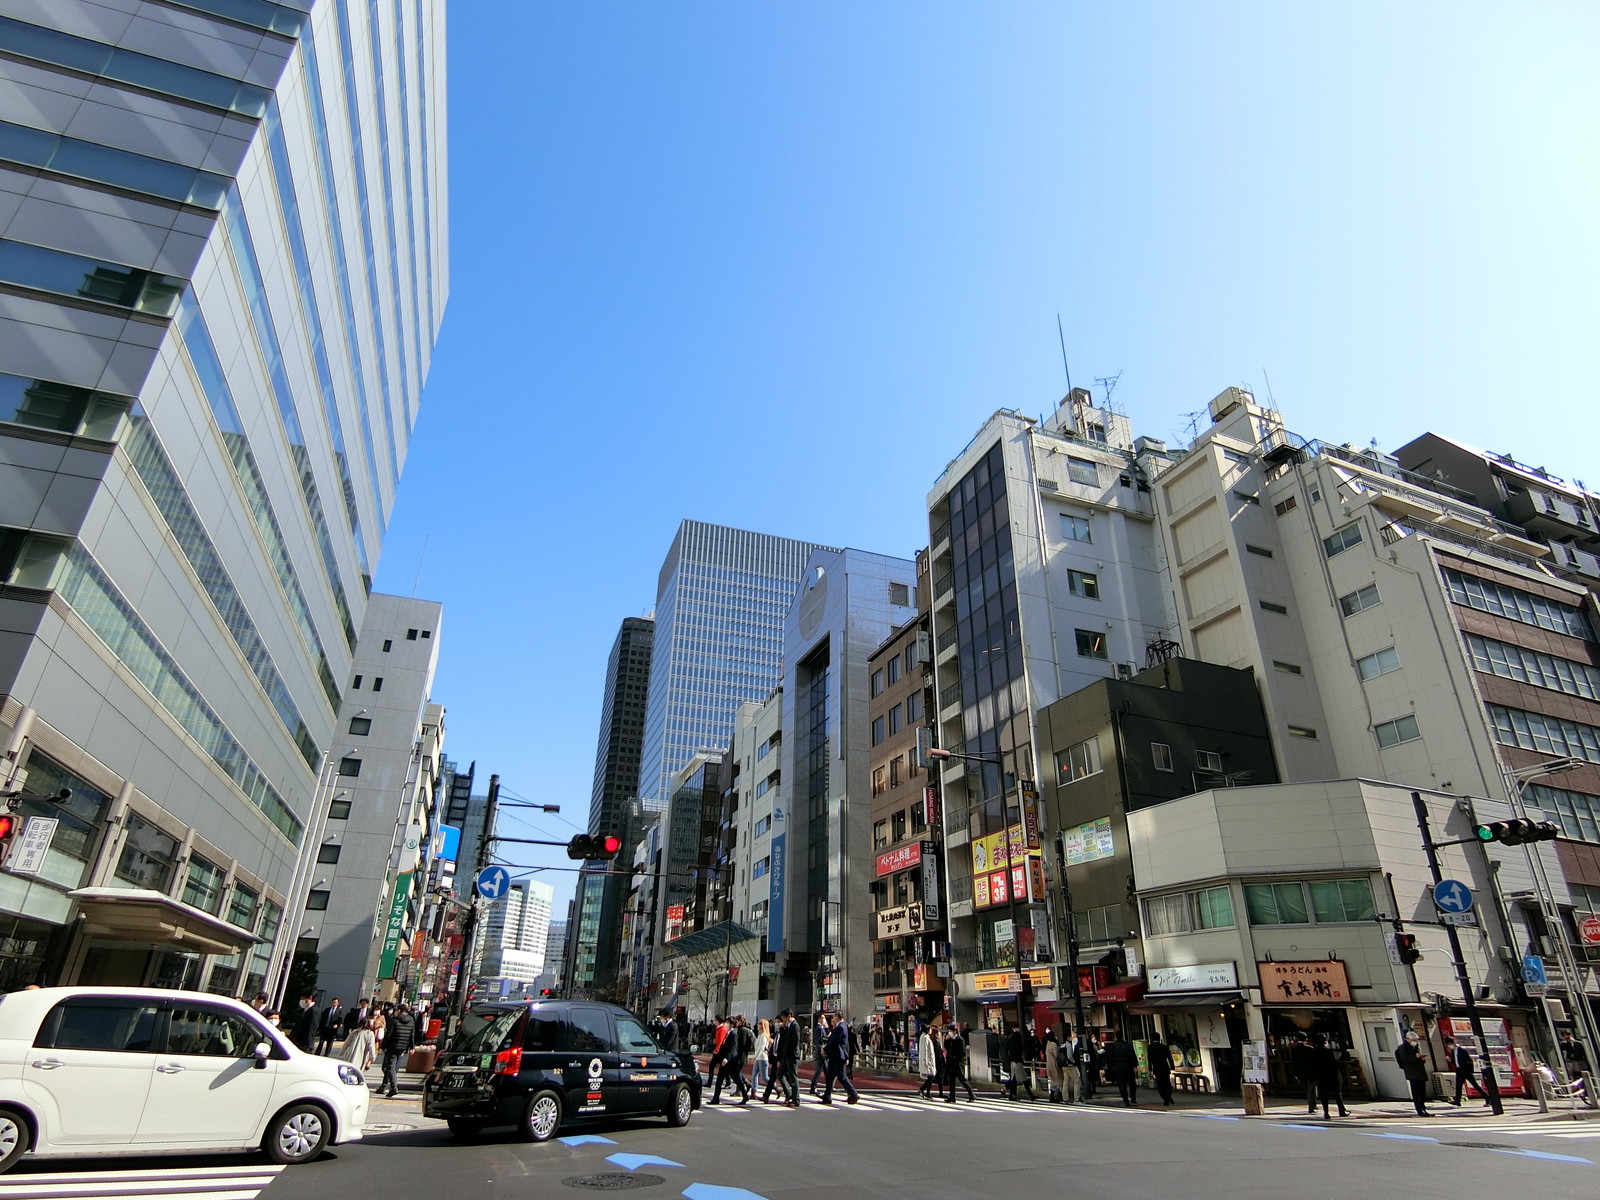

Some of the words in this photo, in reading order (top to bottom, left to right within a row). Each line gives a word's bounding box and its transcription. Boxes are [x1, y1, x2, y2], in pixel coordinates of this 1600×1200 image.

[24, 821, 41, 848] 自転車
[35, 822, 52, 850] 歩行者
[1027, 811, 1036, 842] カラオケ
[21, 849, 37, 869] 専用
[880, 847, 910, 865] ベトナム料理
[773, 845, 782, 900] あなぶきグループ
[976, 881, 987, 891] カラ
[993, 886, 1005, 902] 3F
[977, 892, 987, 902] オケ
[386, 893, 406, 951] りそな銀行
[1290, 966, 1312, 974] うどん
[1277, 979, 1332, 998] 官兵衛
